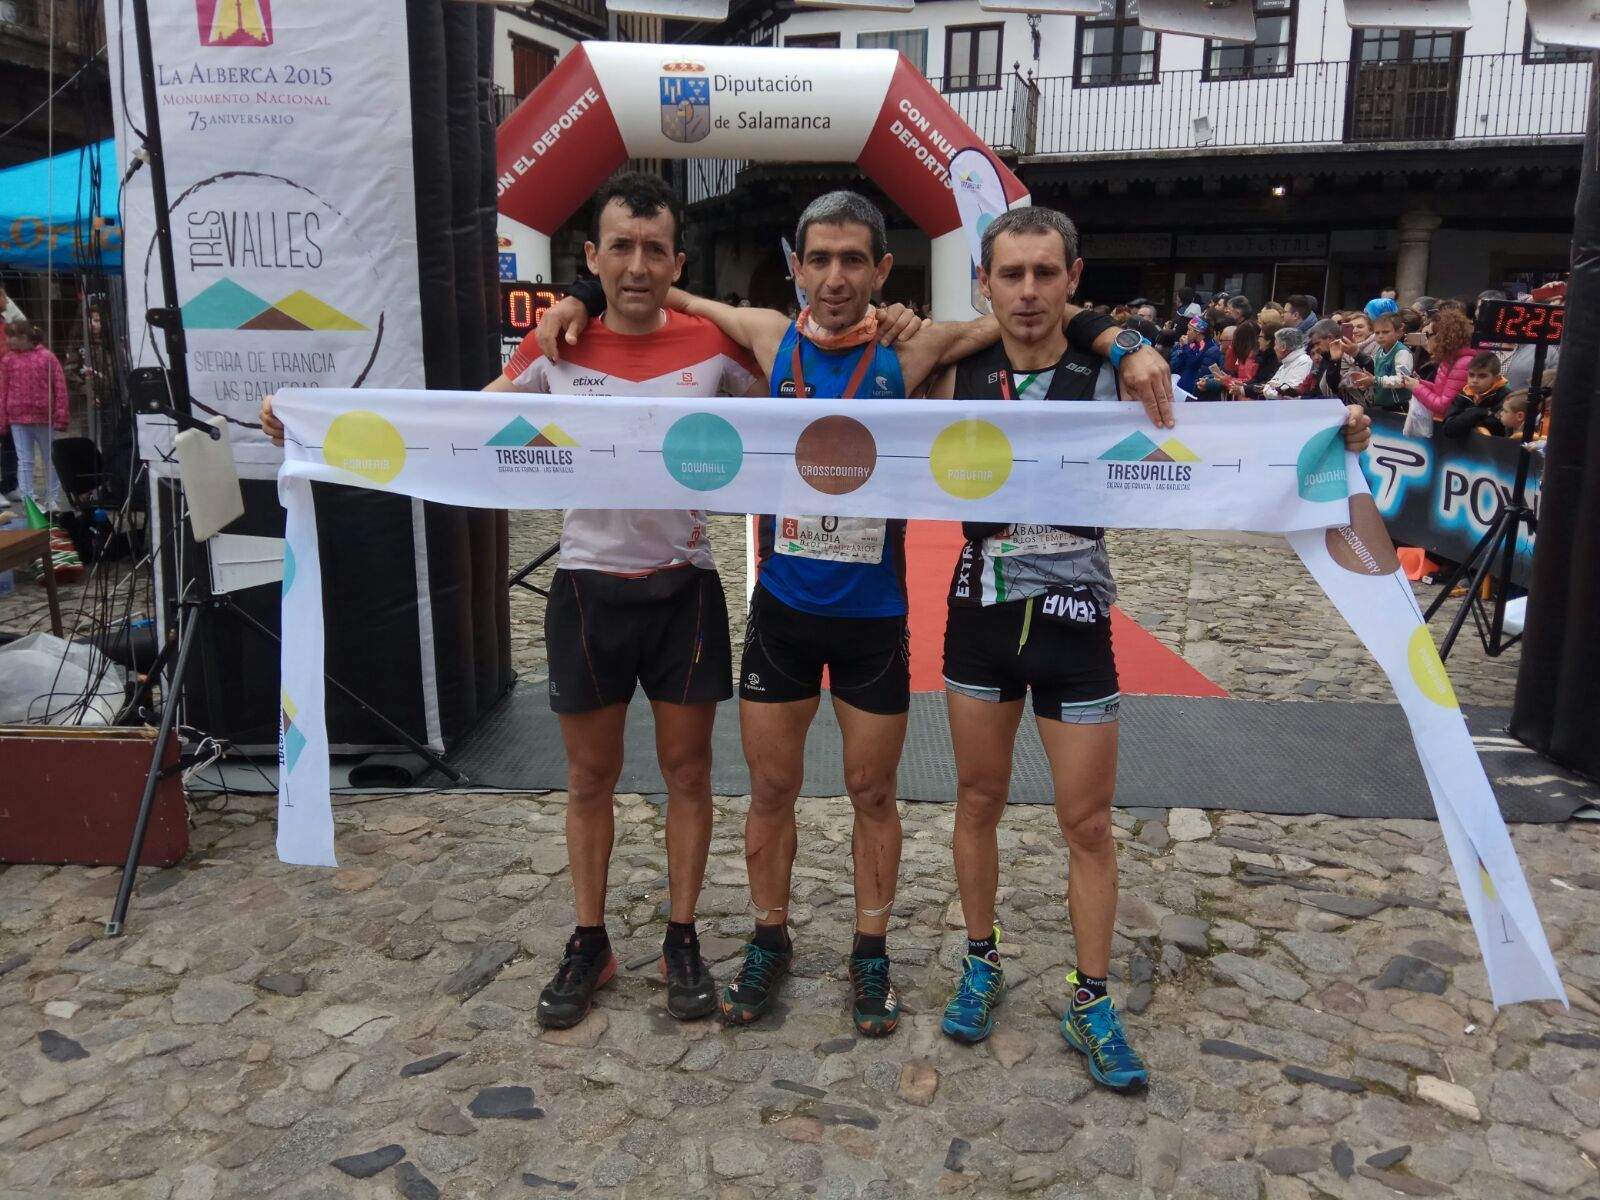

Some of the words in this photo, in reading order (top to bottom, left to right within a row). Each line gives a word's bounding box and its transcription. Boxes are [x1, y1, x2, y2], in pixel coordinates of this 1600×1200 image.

[158, 64, 183, 86] LA
[188, 62, 279, 84] ALBERCA
[284, 65, 333, 86] 2015
[713, 74, 813, 96] Diputación
[162, 94, 250, 106] MONUMENTO
[256, 91, 331, 106] NACIONAL
[188, 111, 207, 131] 75
[209, 114, 294, 125] ANIVERSARIO
[714, 116, 730, 129] de
[737, 110, 832, 130] Salamanca
[899, 98, 930, 132] CON
[928, 128, 959, 160] NUE
[512, 155, 536, 175] EL
[532, 87, 600, 157] DEPORTE
[889, 119, 955, 189] DEPORTIS
[188, 209, 224, 272] TRES
[221, 211, 323, 269] VALLES
[194, 351, 243, 373] SIERRA
[248, 351, 268, 373] DE
[272, 352, 336, 373] FRANCIA
[214, 381, 240, 401] LAS
[495, 449, 573, 465] TRESVALLES
[681, 461, 726, 474] DOWNHILL
[801, 465, 870, 478] CROSSCOUNTRY
[1107, 463, 1192, 481] TRESVALLES
[800, 530, 841, 544] ABADIA
